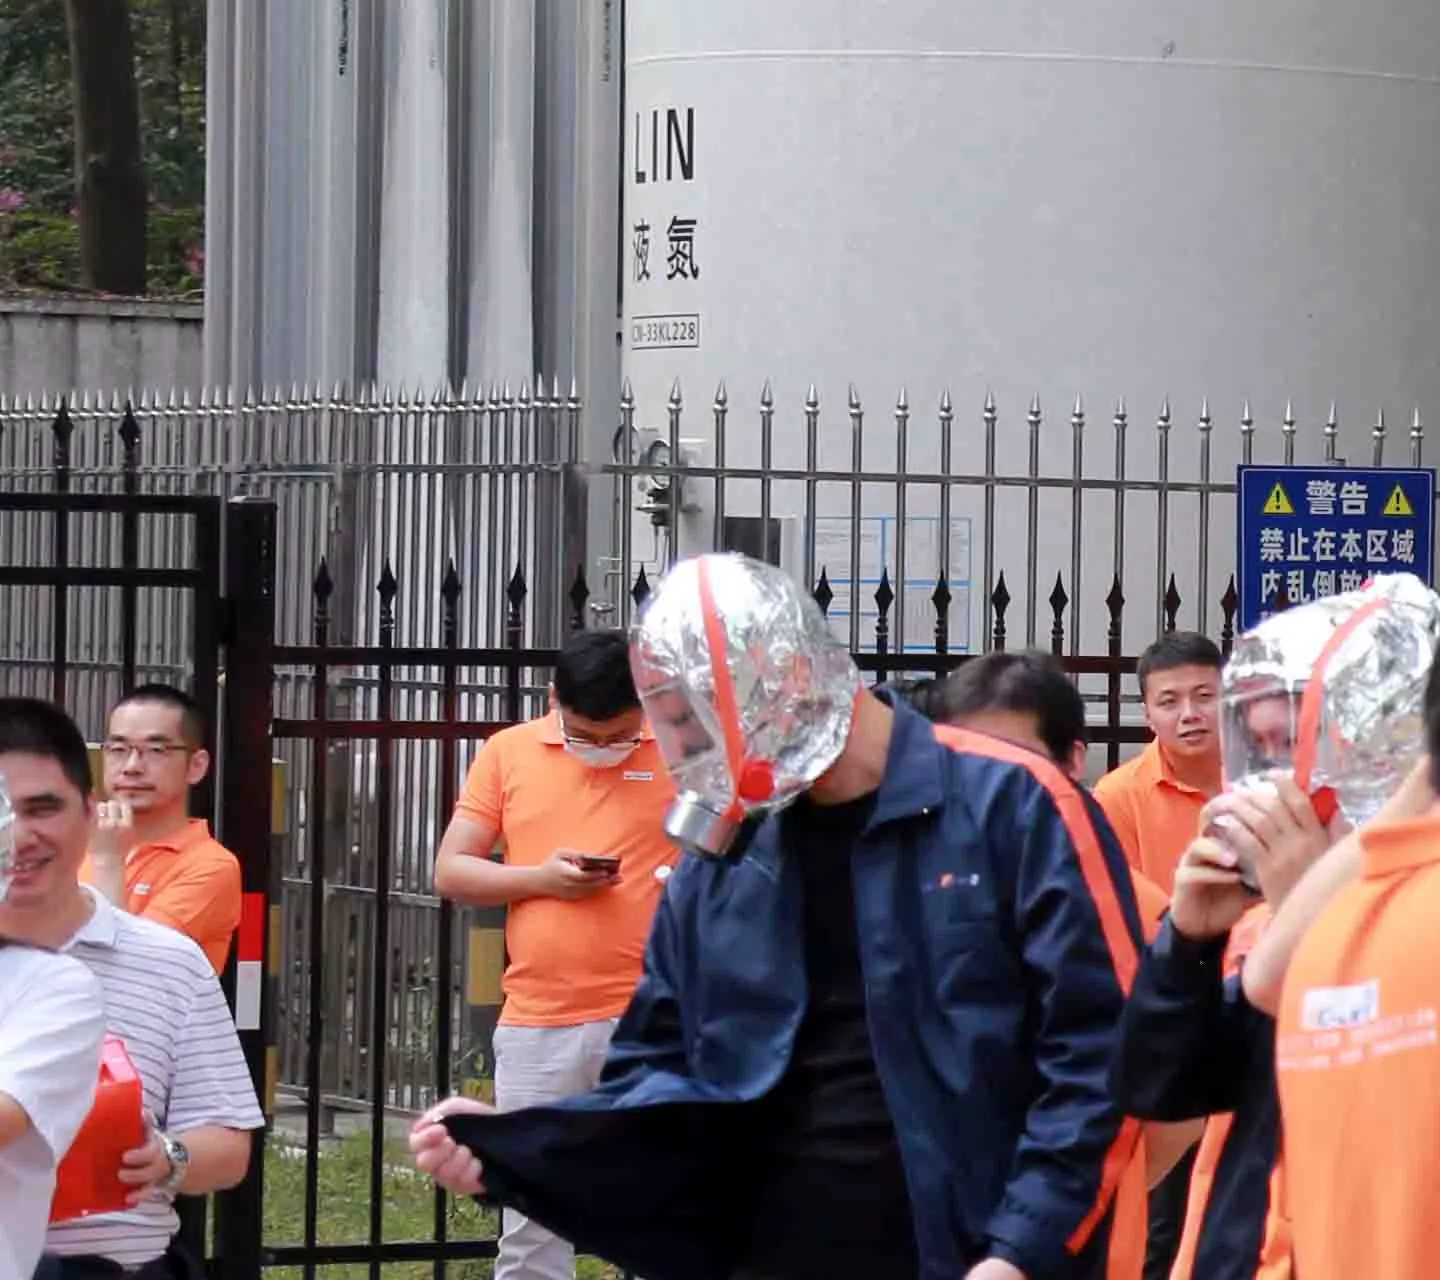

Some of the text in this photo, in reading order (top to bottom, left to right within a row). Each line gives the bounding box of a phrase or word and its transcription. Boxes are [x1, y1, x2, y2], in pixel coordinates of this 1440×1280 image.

[634, 107, 696, 184] LIN
[632, 215, 699, 282] 液氮
[1305, 479, 1369, 515] 警告
[1260, 527, 1416, 563] 禁止在本区域
